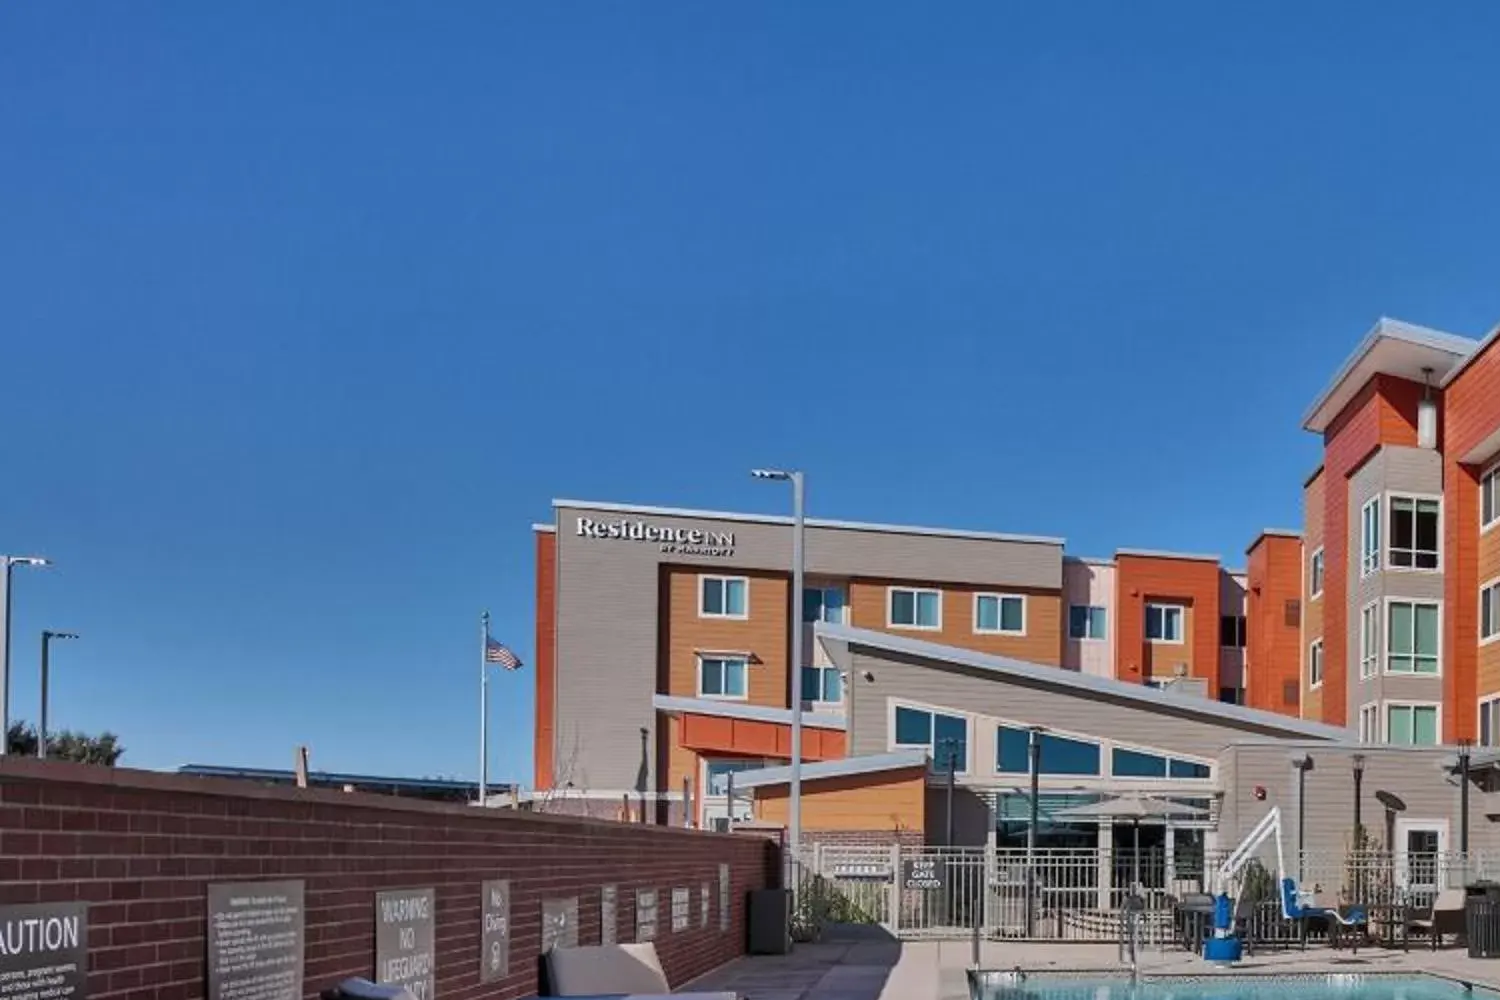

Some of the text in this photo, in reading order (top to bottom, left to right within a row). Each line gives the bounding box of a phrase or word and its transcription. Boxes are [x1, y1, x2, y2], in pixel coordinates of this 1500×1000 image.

[576, 517, 735, 547] Residence INN
[911, 870, 935, 878] GATE
[399, 927, 415, 950] NO
[383, 954, 431, 983] LIFEGUARD
